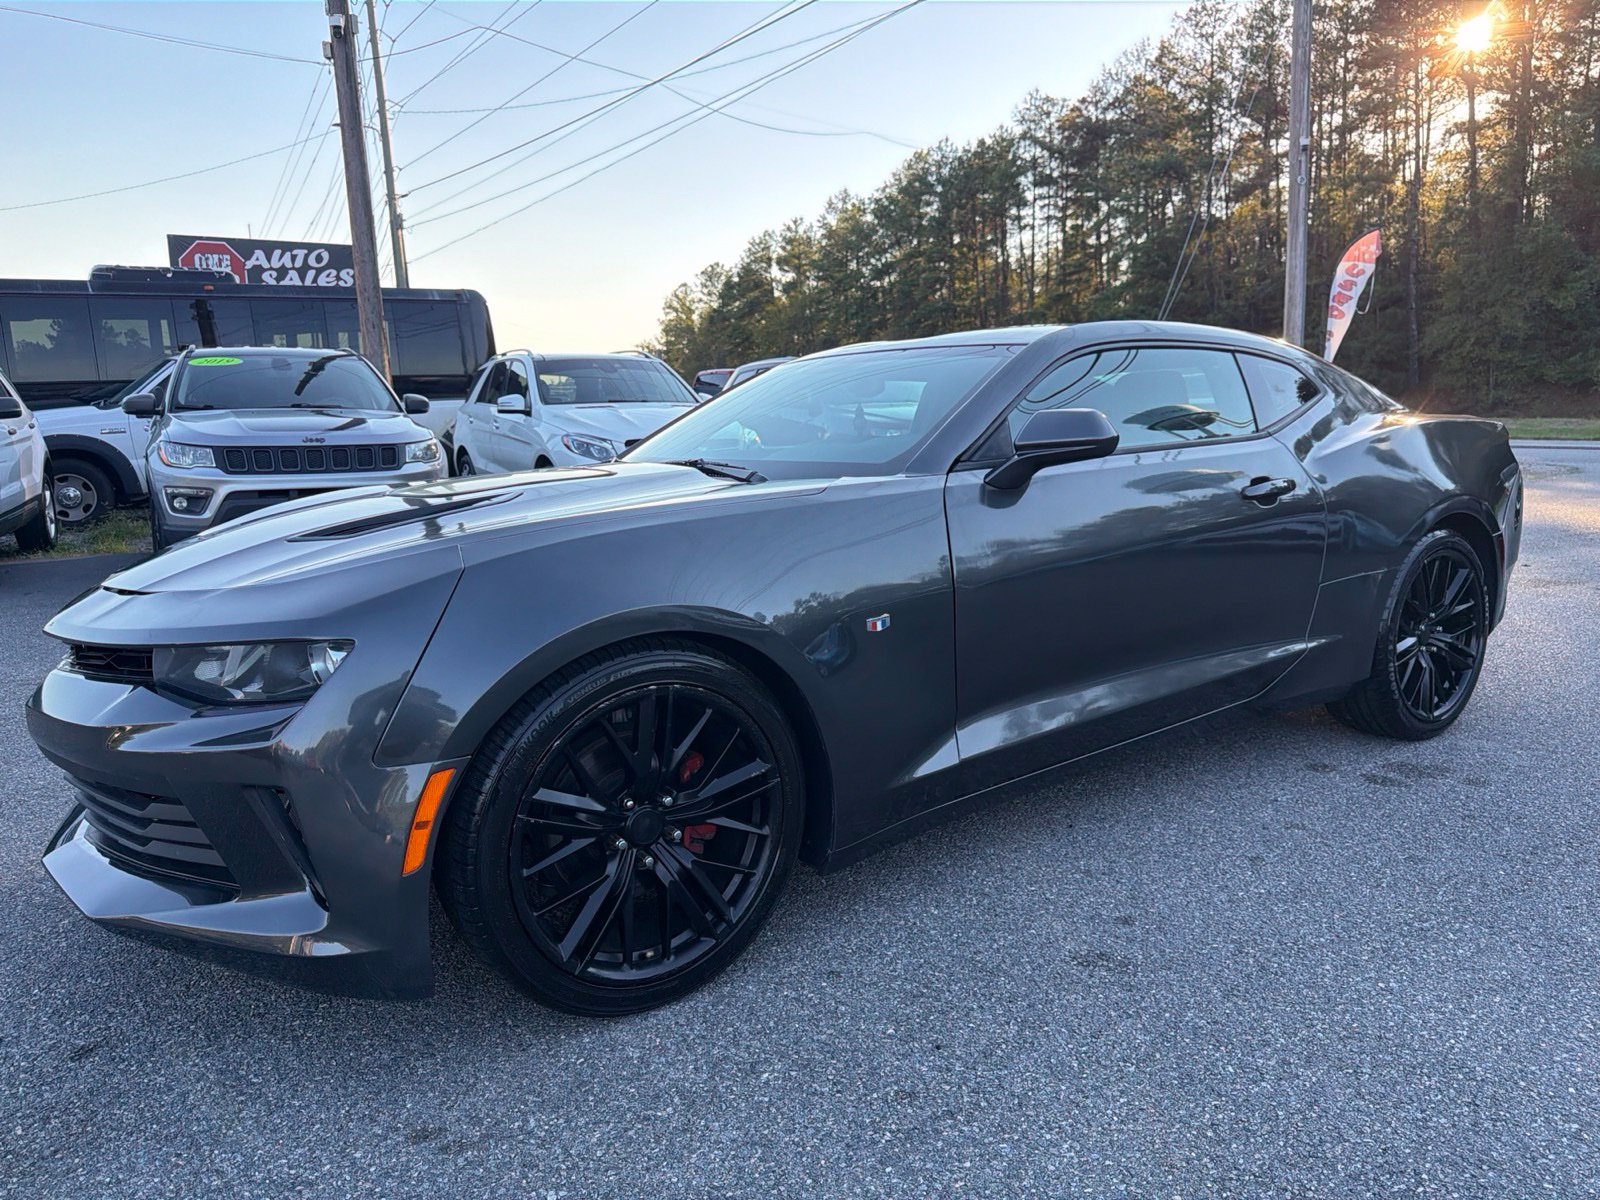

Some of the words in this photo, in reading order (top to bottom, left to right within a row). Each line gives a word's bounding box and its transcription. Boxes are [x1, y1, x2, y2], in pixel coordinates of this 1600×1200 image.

[245, 248, 330, 269] AUTO
[261, 268, 354, 287] SALES
[302, 436, 326, 444] Jeep
